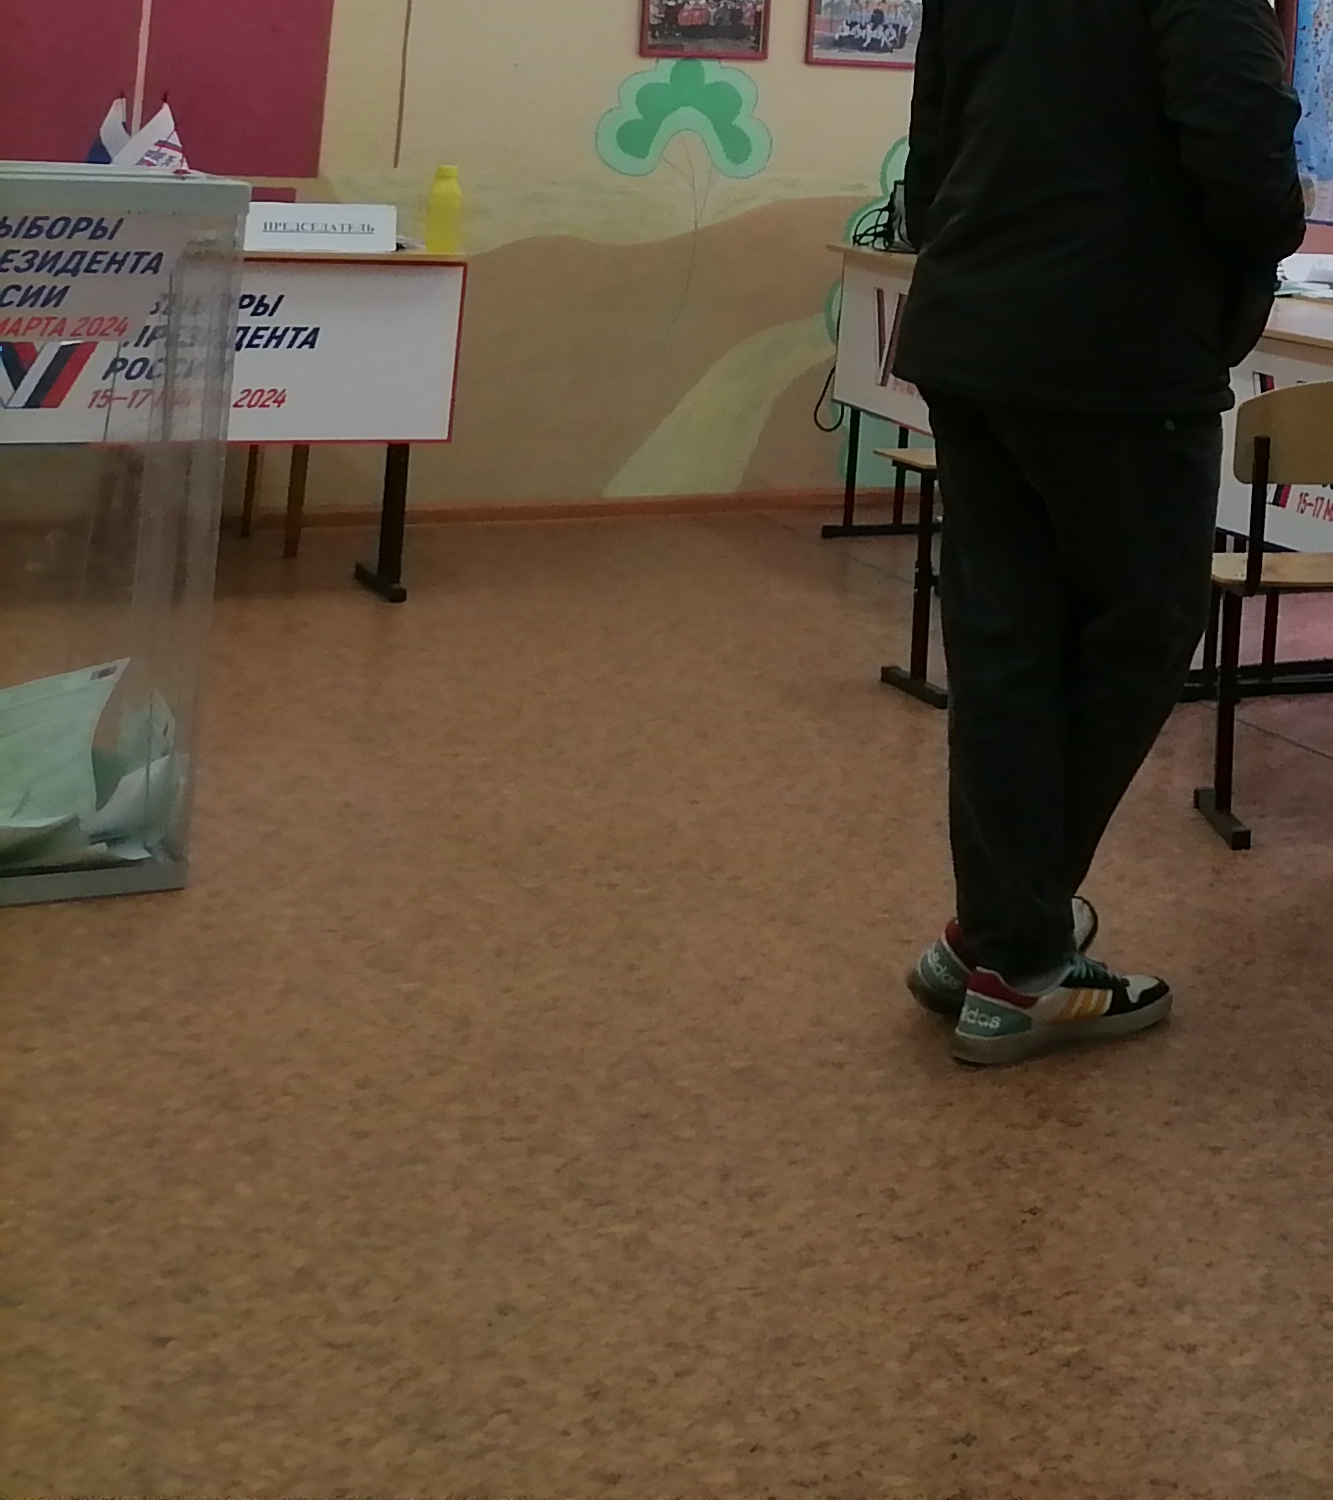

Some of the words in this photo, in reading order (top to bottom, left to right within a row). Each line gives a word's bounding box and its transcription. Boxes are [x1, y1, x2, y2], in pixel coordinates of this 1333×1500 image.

[0, 216, 125, 241] ЫБОРЫ
[0, 249, 164, 277] ЕЗИДЕНТА
[0, 284, 70, 309] СИИ
[70, 316, 129, 337] 2024
[233, 389, 287, 409] 2024
